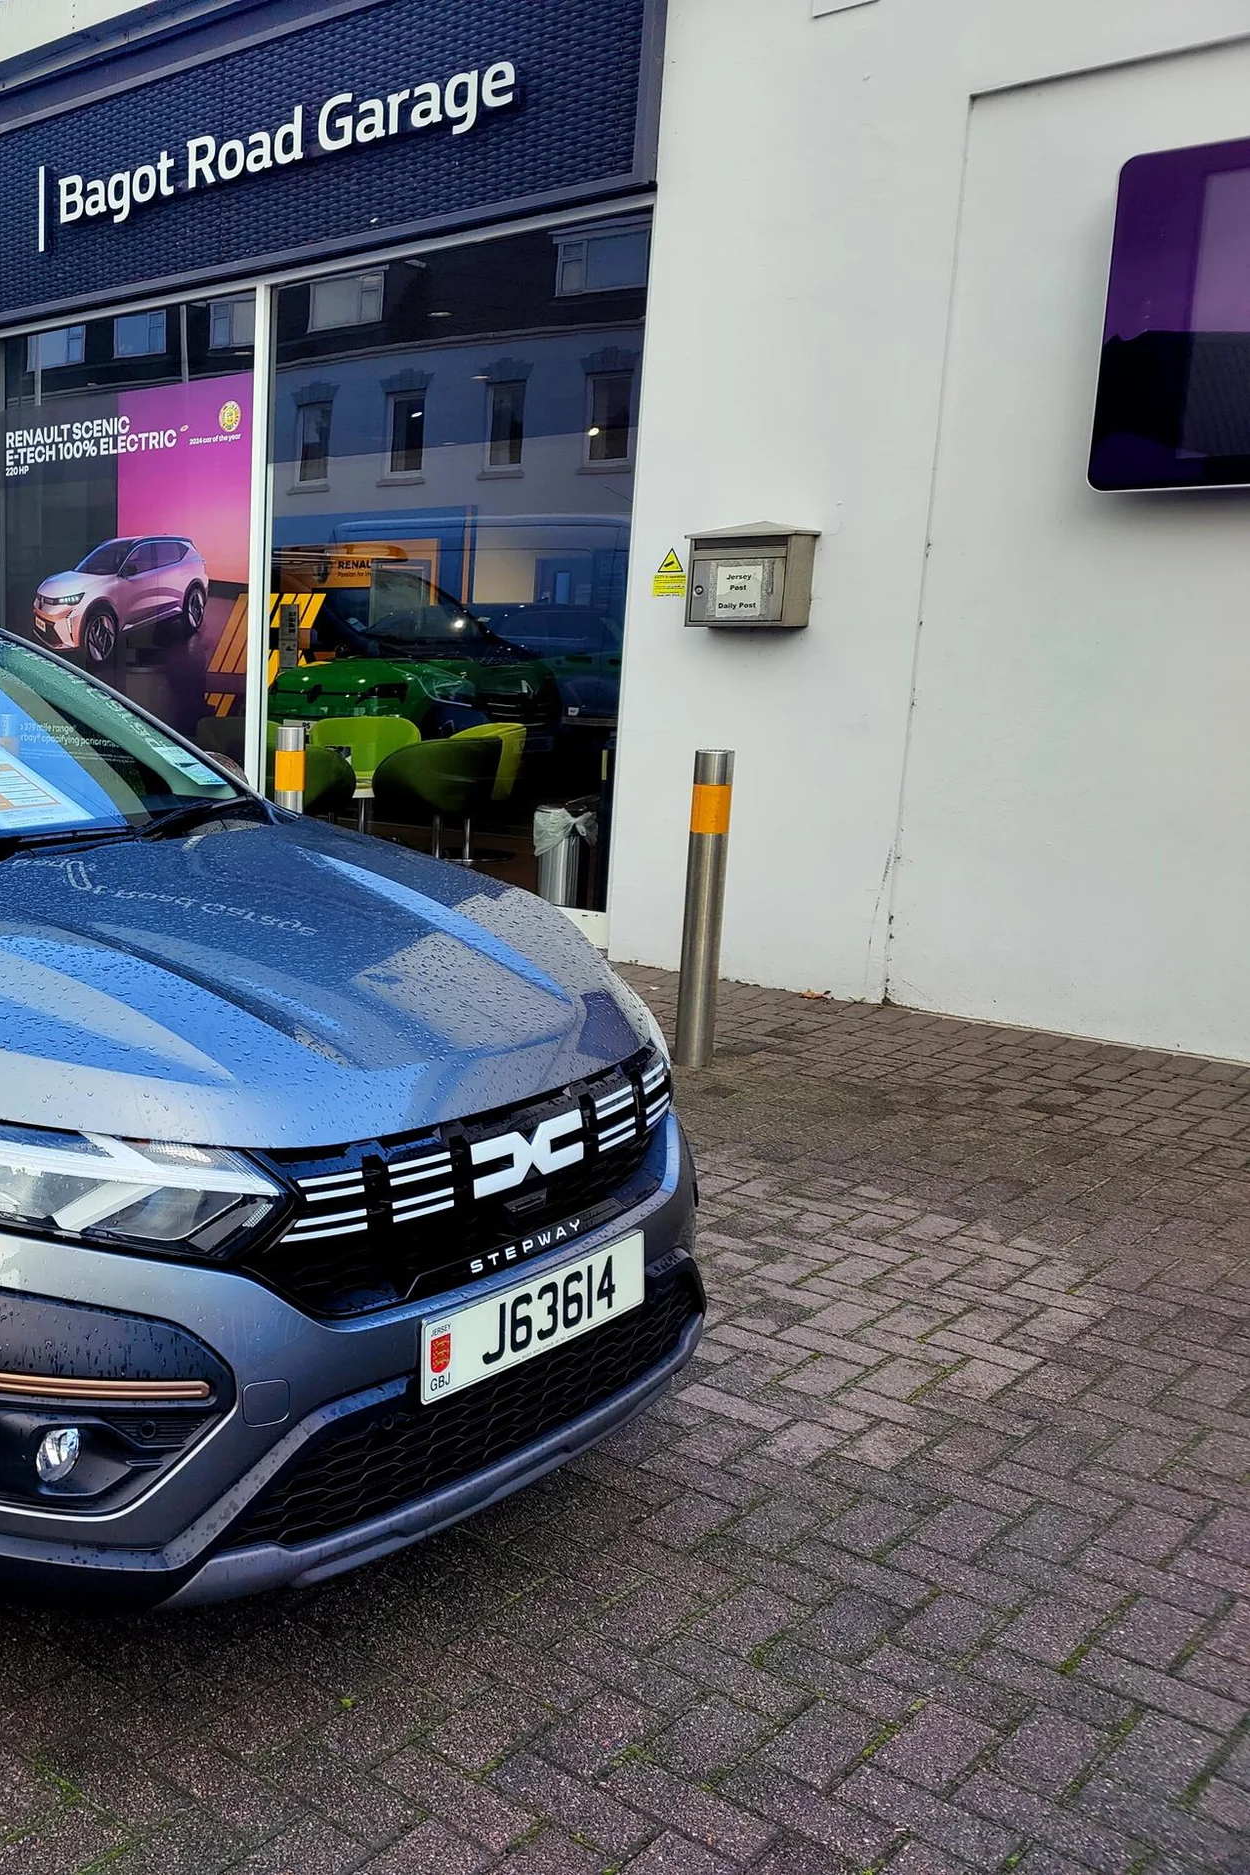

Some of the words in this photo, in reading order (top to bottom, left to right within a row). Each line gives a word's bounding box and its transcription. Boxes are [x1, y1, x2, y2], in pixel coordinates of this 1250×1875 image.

[58, 150, 175, 224] Bagot
[186, 104, 304, 190] Road
[317, 60, 516, 151] Garage
[5, 423, 71, 448] RENAULT
[72, 415, 131, 440] SCENIC
[228, 433, 241, 442] year
[5, 444, 57, 466] E-TECH
[58, 439, 98, 461] 100%
[100, 429, 178, 455] ELECTRIC
[5, 466, 19, 476] 220
[19, 465, 30, 475] HP
[718, 602, 737, 610] Daily
[470, 1218, 582, 1274] STEPWAY
[481, 1254, 617, 1366] J63614
[430, 1322, 452, 1338] JERSEY
[429, 1372, 451, 1392] GBJ
